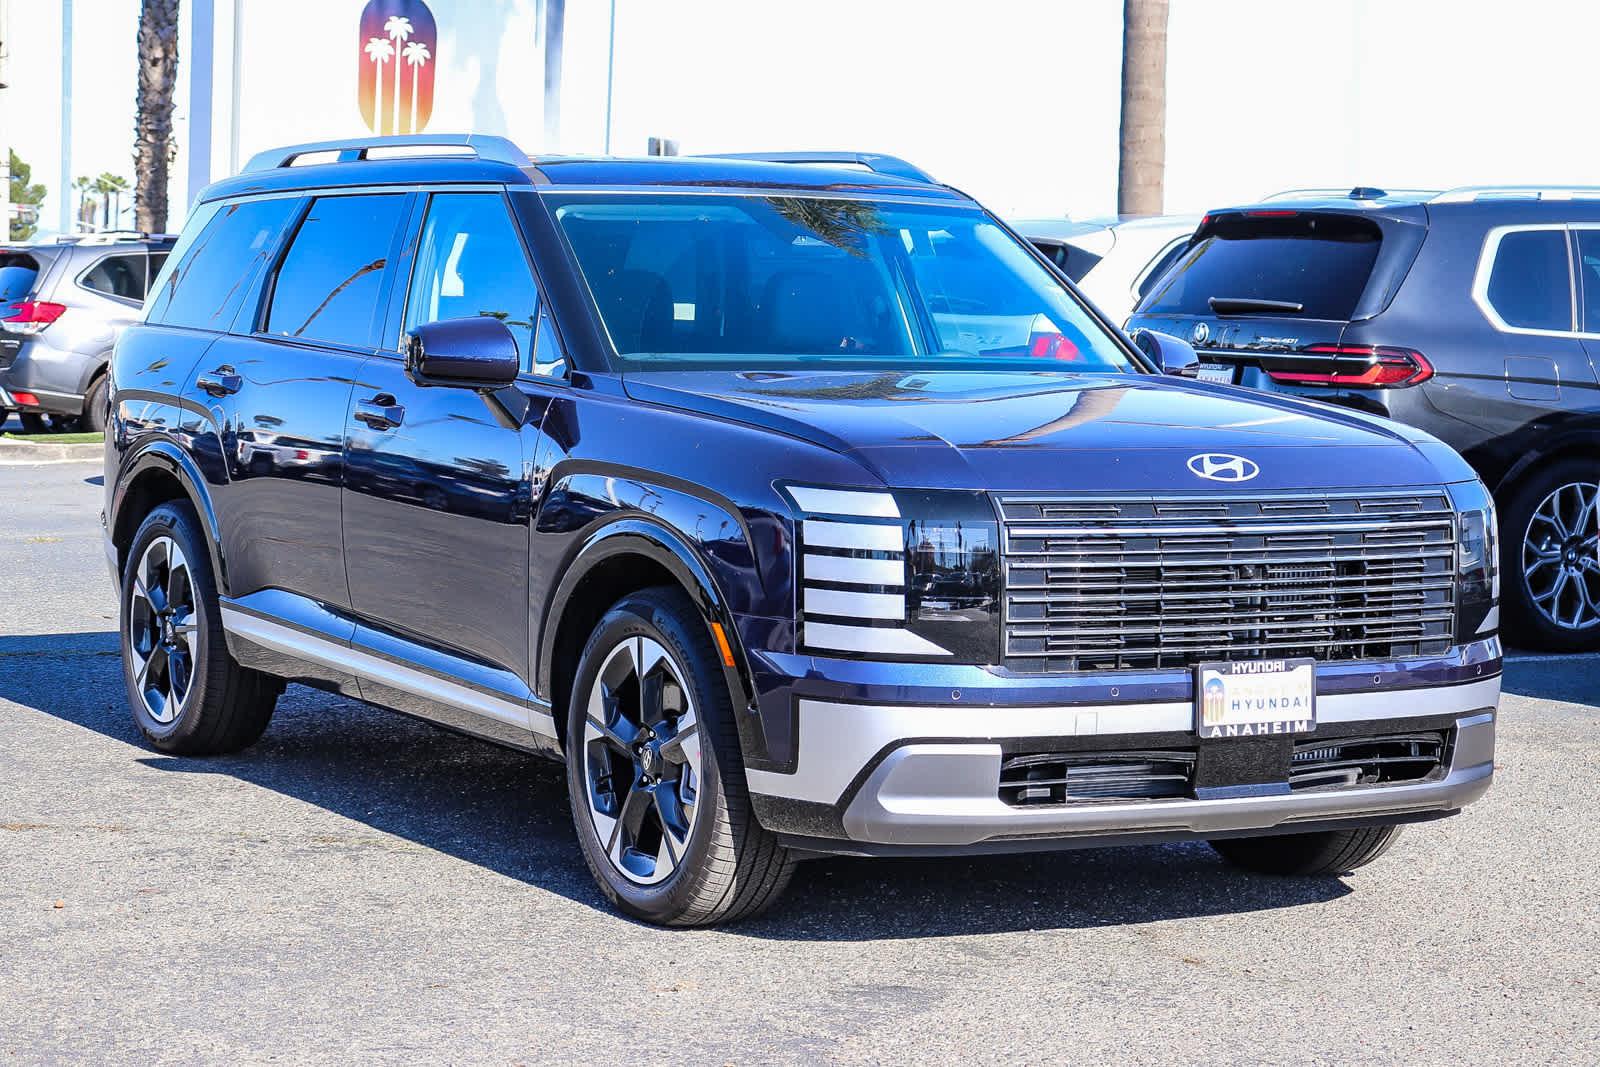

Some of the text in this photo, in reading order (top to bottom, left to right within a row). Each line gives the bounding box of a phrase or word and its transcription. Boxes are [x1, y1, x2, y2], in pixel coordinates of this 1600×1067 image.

[1232, 661, 1285, 673] HYUNDAI
[1232, 696, 1308, 710] HYUNDAI
[1211, 720, 1308, 738] ANAHEIM
